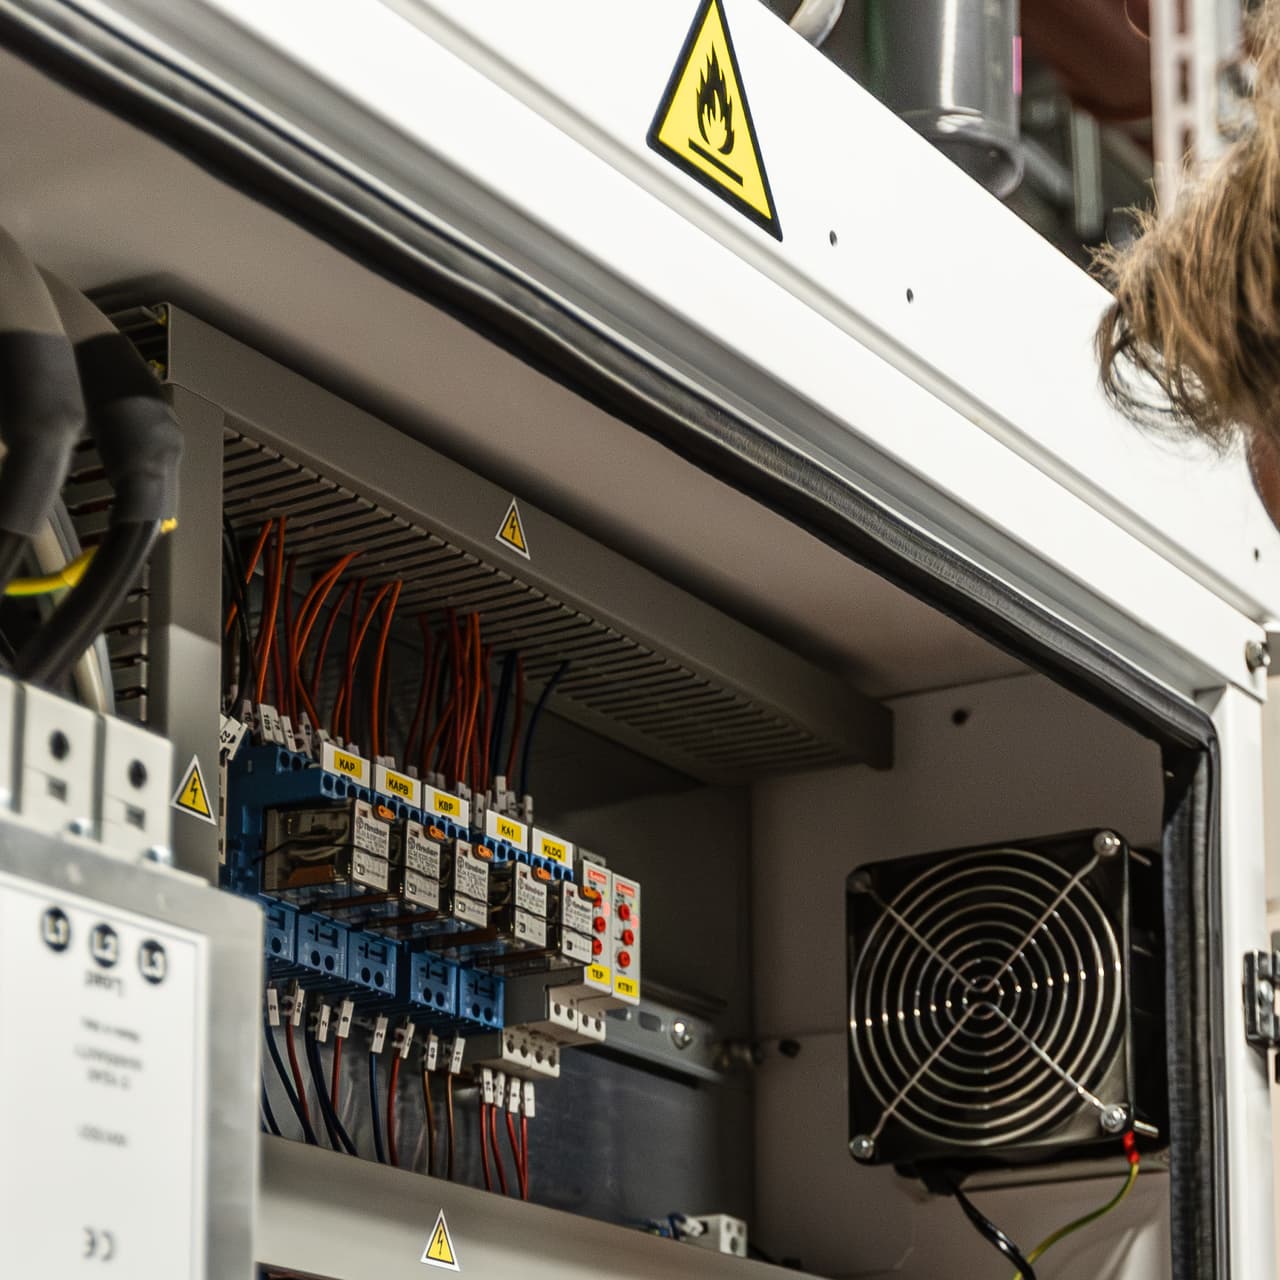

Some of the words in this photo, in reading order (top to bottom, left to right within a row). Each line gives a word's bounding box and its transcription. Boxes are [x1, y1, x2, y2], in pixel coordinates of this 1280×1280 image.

[339, 759, 355, 771] KAP
[388, 779, 409, 795] KAPB
[501, 824, 515, 837] KA1
